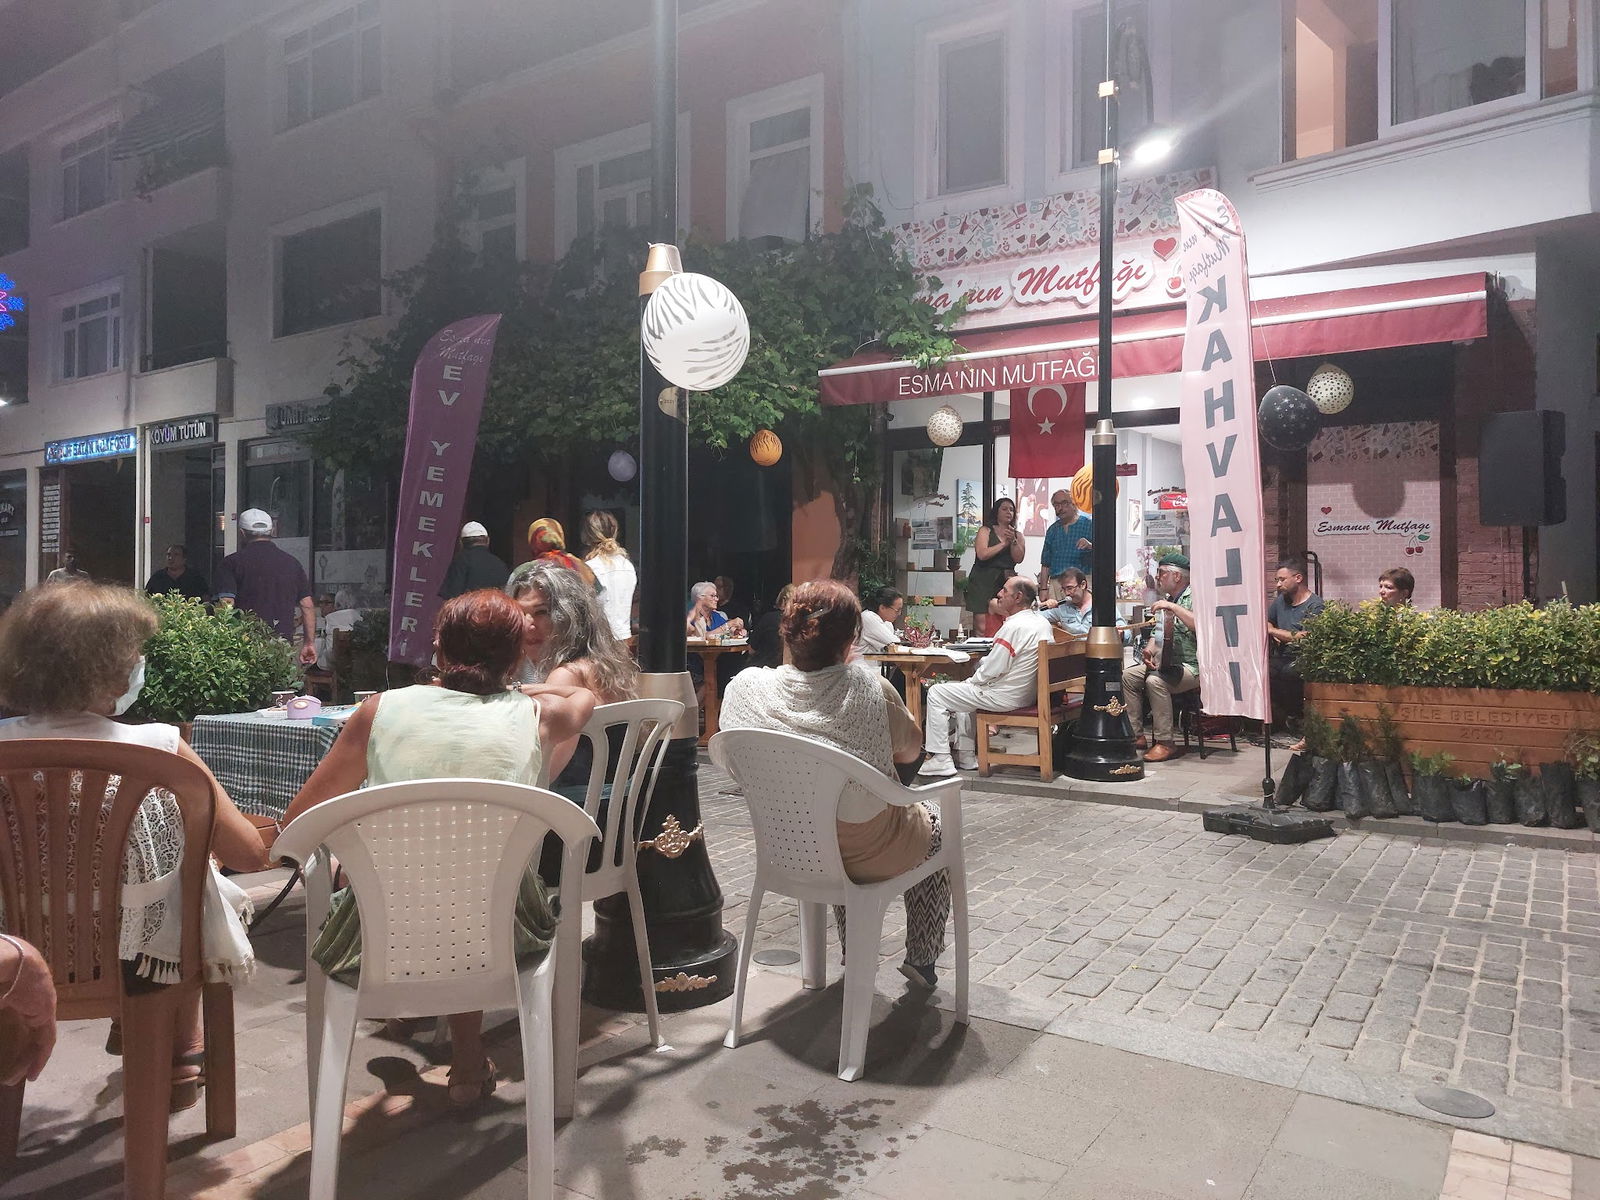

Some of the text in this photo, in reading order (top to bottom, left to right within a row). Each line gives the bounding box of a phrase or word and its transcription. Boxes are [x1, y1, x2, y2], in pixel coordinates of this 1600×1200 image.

[1017, 258, 1147, 297] Mutfğı
[437, 364, 464, 407] EV
[178, 418, 207, 440] TÜTÜN
[1317, 520, 1371, 533] Esmanın
[1449, 708, 1571, 727] BELEDİYESİ
[1459, 727, 1504, 742] 2020
